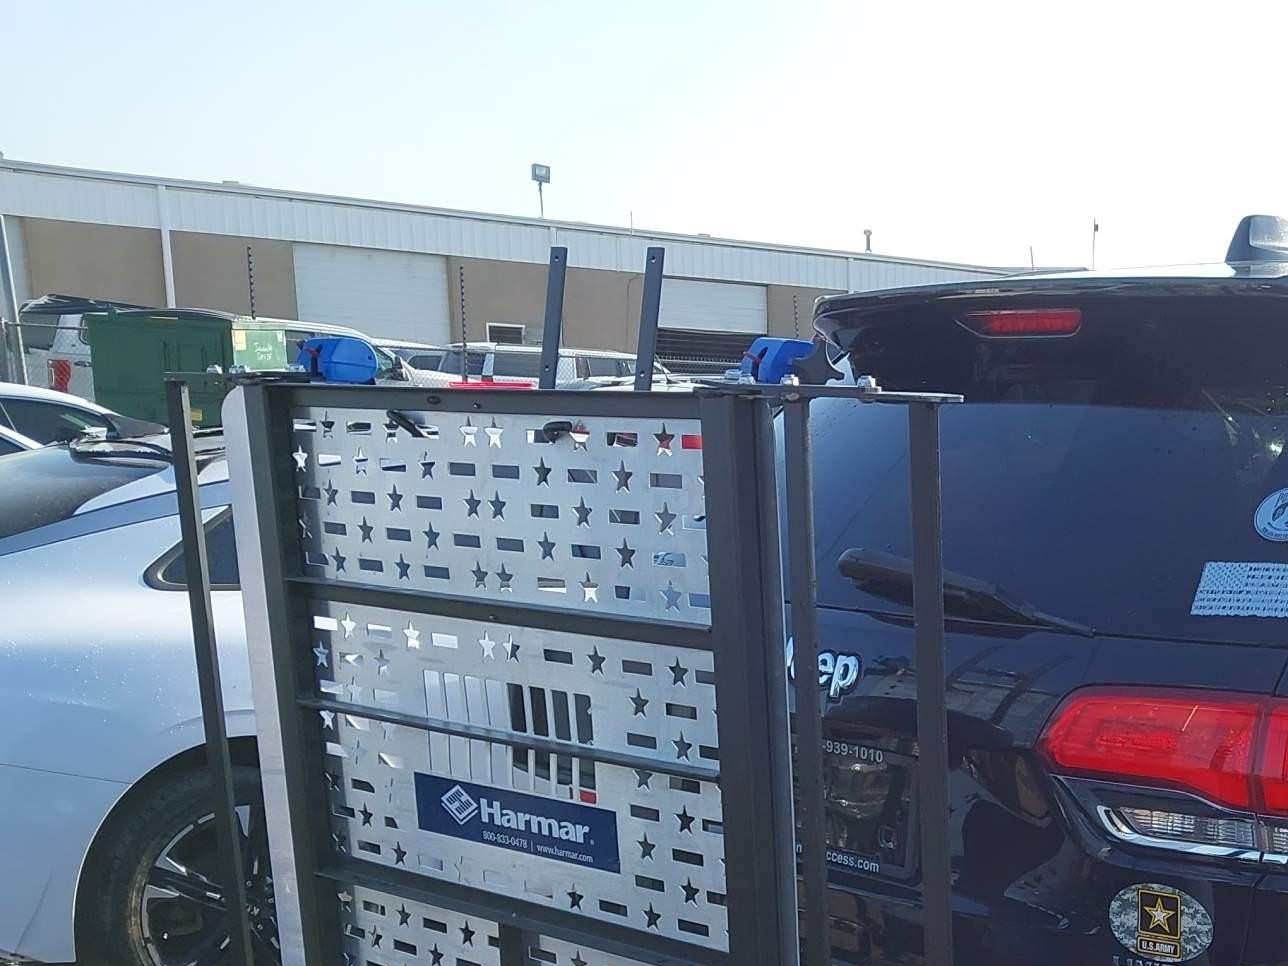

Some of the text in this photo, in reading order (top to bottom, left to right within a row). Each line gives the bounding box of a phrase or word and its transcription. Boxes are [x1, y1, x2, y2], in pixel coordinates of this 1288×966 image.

[821, 740, 884, 763] -939-1010
[479, 797, 591, 844] Harmar
[482, 830, 528, 849] 800-833-0478
[536, 844, 594, 863] www.harmar.com
[825, 850, 880, 873] ccess.com
